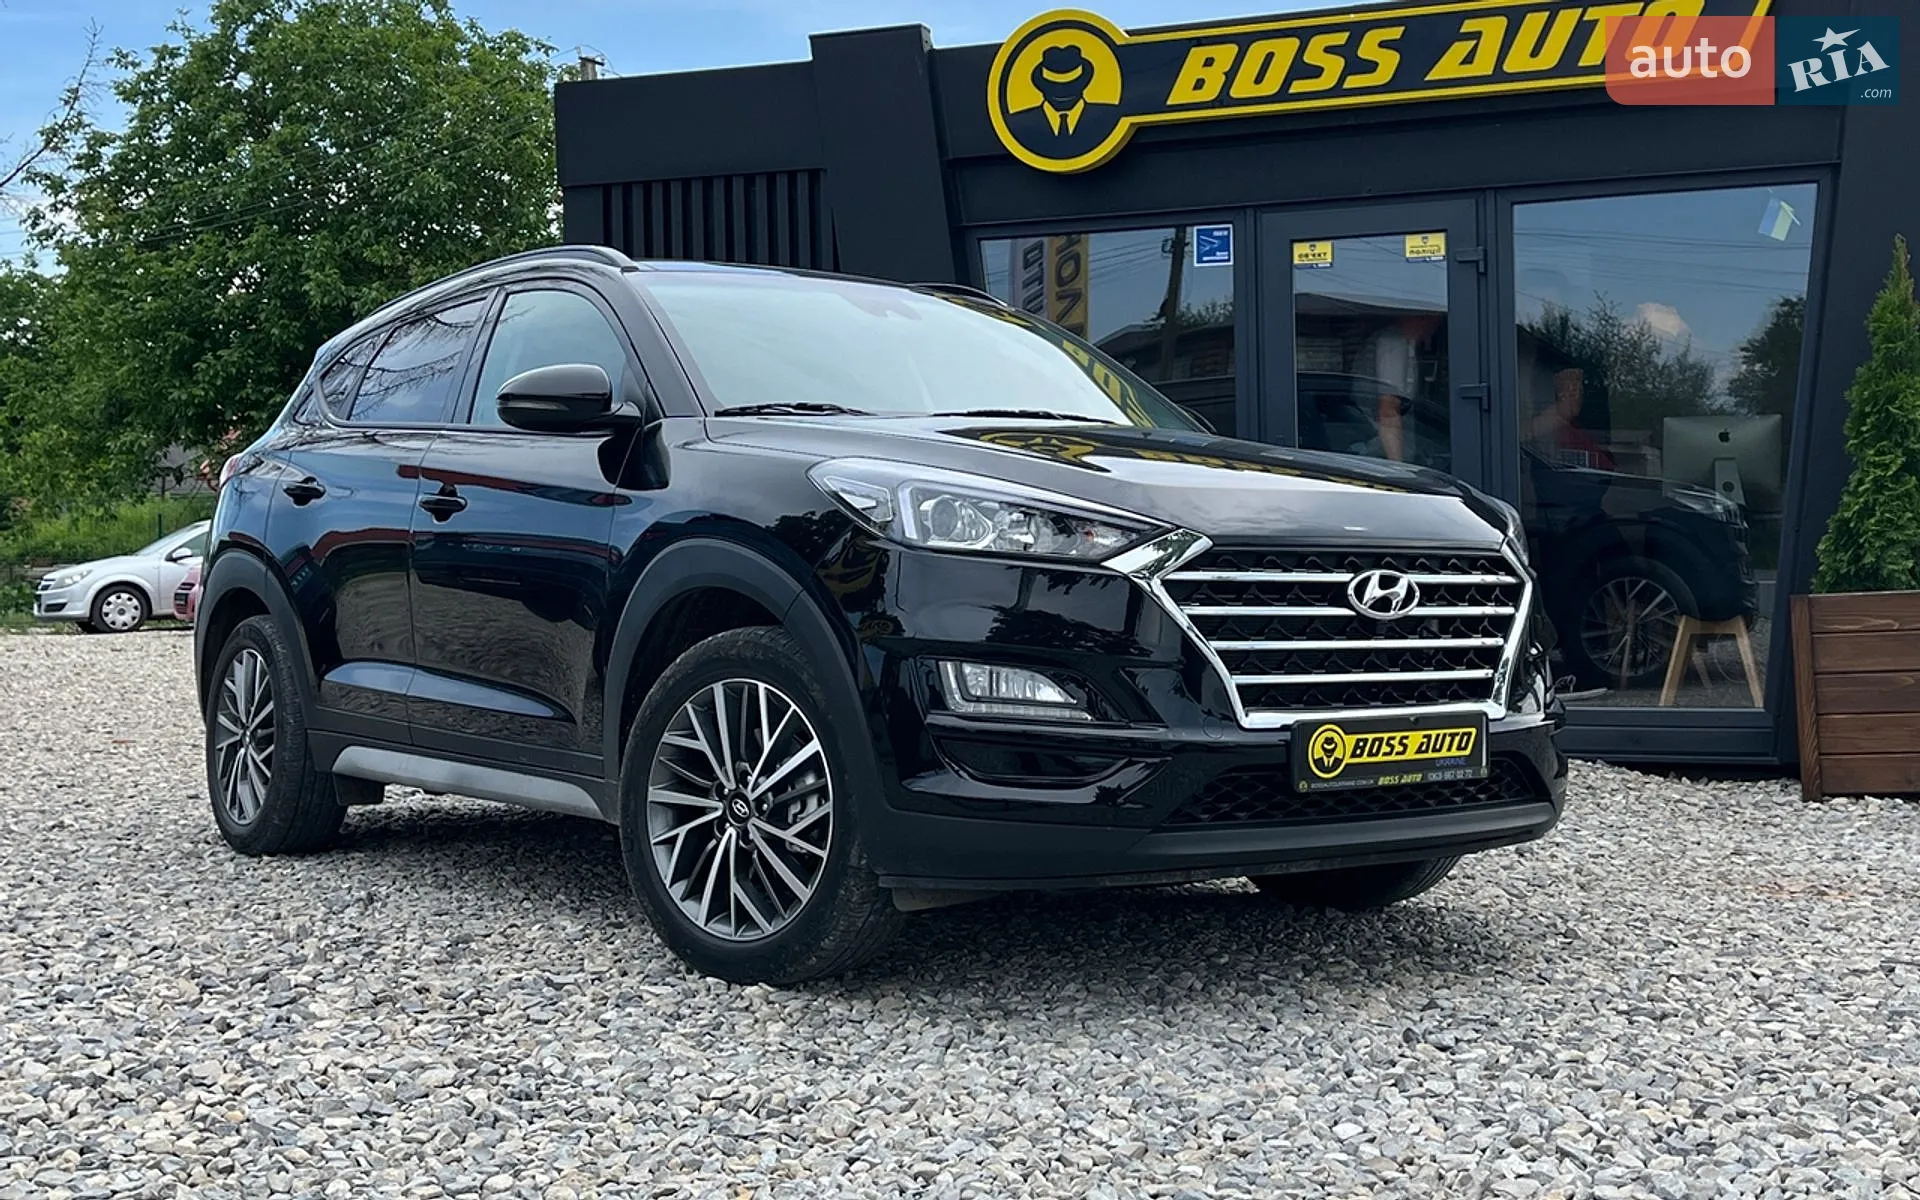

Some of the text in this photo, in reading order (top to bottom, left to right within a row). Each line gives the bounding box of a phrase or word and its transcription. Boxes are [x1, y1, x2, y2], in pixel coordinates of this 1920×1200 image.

[1166, 0, 1705, 105] BOSS AUTO
[1350, 731, 1473, 759] BOSS AUTO
[1378, 775, 1400, 786] BOSS
[1401, 773, 1423, 783] AUTO
